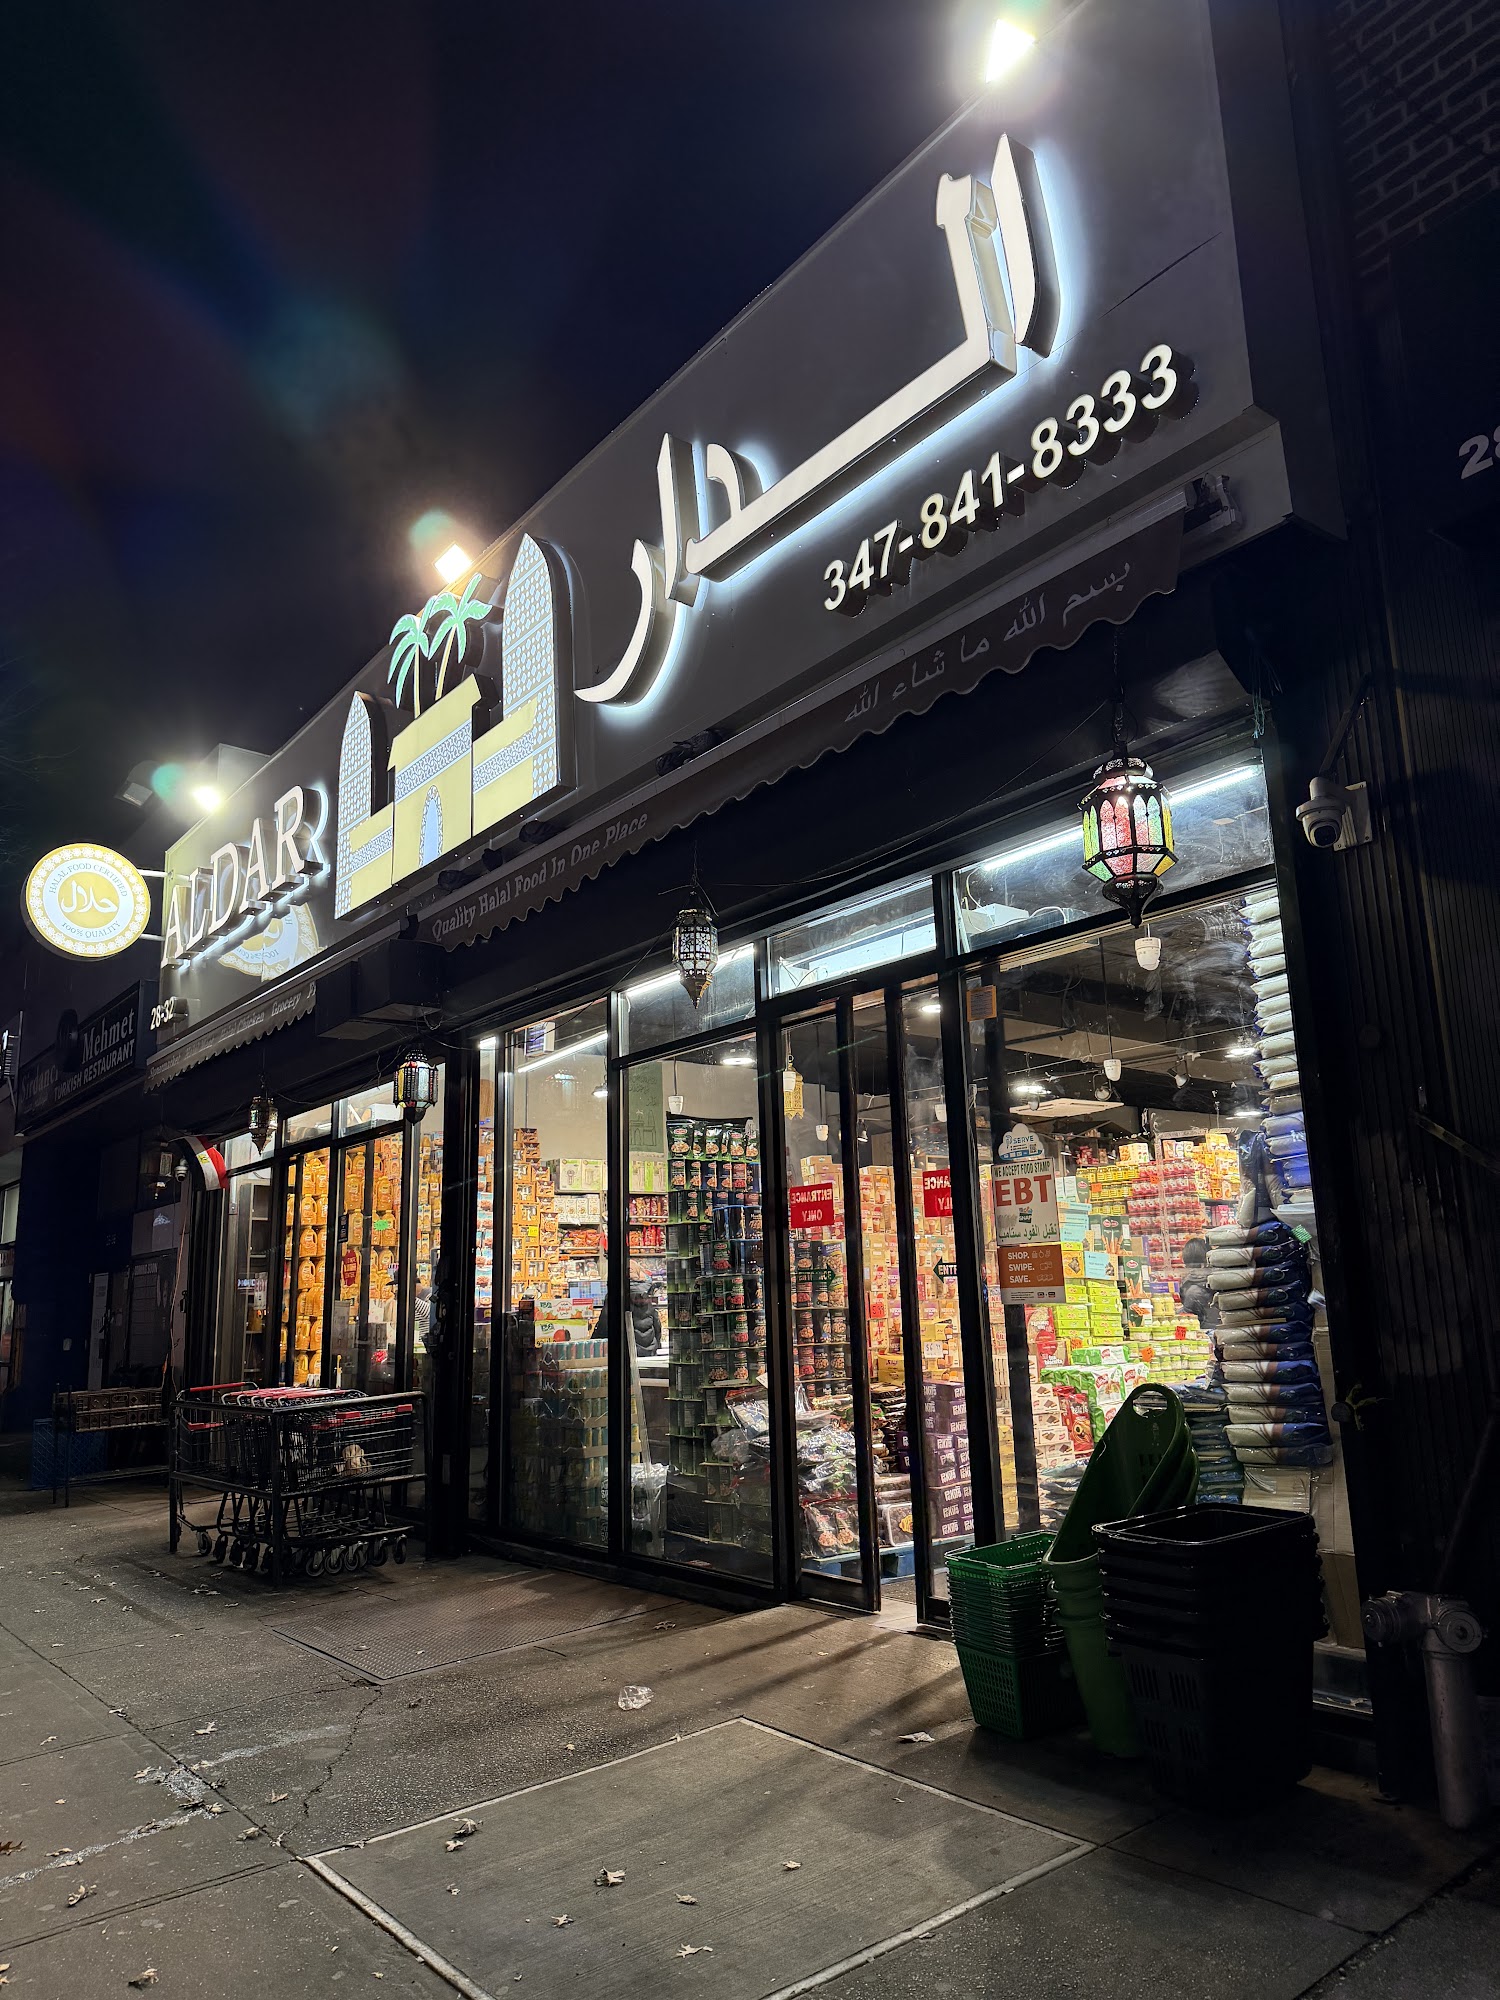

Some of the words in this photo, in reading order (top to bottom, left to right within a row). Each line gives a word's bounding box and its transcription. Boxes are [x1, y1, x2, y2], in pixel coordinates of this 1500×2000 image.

[574, 132, 1037, 704] الدار
[823, 344, 1177, 612] 347-841-8333
[1062, 561, 1131, 628] بسم
[1003, 592, 1047, 642] الله
[960, 634, 991, 664] ما
[892, 650, 946, 702] شاء
[844, 681, 881, 723] الله
[49, 870, 69, 894] HALAL
[68, 862, 92, 873] FOOD
[93, 864, 128, 897] CERTIFIED
[160, 785, 305, 970] ALDAR
[432, 905, 476, 942] Quality
[478, 881, 511, 916] Halal
[514, 861, 547, 897] Food
[550, 856, 566, 879] In
[570, 839, 601, 867] One
[603, 813, 648, 849] Place
[60, 880, 118, 914] حلال
[61, 922, 84, 937] 100%
[84, 920, 121, 938] QUALITY
[149, 996, 176, 1032] 28-32
[271, 992, 302, 1017] Grocery
[81, 1008, 135, 1065] Mehmet
[54, 1072, 82, 1102] TURKISH
[83, 1038, 136, 1085] RESTAURANT
[993, 1167, 1002, 1177] WE
[1002, 1164, 1020, 1177] ACCEPT
[1020, 1162, 1034, 1174] FOOD
[1034, 1160, 1051, 1173] STAMP
[994, 1174, 1052, 1207] EBT
[1007, 1251, 1030, 1260] SHOP.
[1008, 1263, 1035, 1271] SWIPE.
[1009, 1275, 1031, 1283] SAVE.
